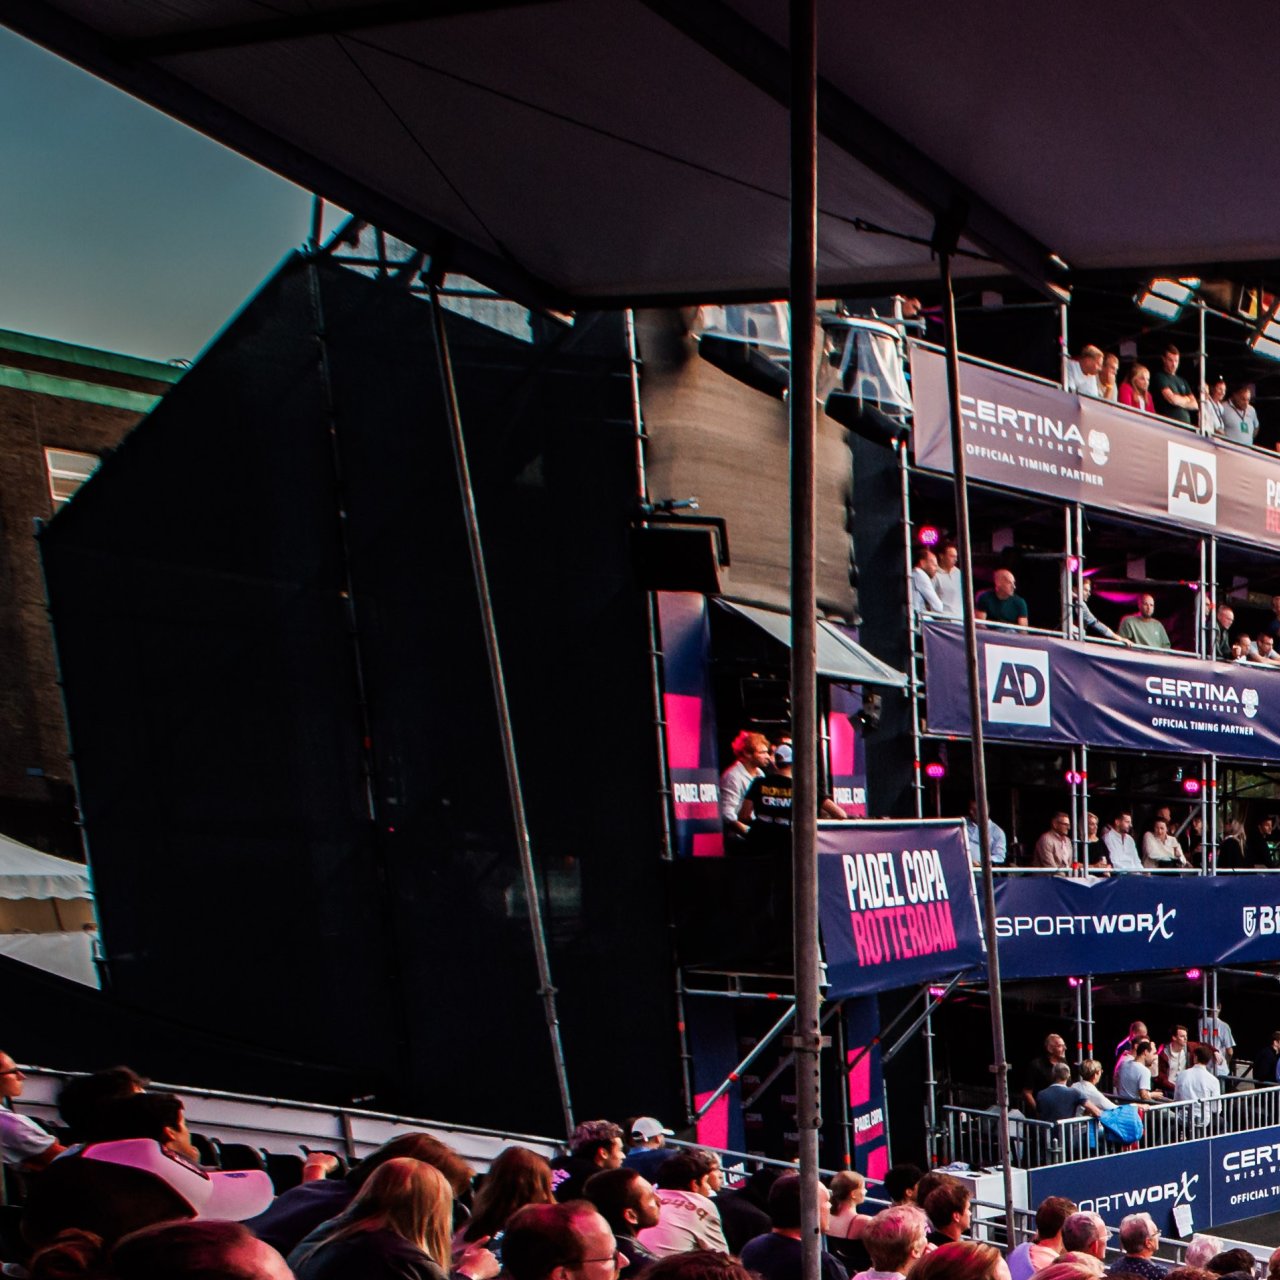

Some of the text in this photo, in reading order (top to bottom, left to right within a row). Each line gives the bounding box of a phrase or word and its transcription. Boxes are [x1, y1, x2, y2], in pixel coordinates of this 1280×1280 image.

[960, 395, 1085, 445] CERTINA
[966, 443, 1103, 486] OFFICIAL TIMING PARTNER
[1172, 460, 1213, 505] AD
[992, 662, 1045, 707] AD
[1146, 676, 1239, 703] CERTINA
[1152, 717, 1254, 736] OFFICIAL TIMING PARTNER
[843, 849, 949, 910] PADEL COPA
[851, 901, 957, 967] ROTTERDAM
[995, 902, 1176, 942] SPORTWORX
[1073, 1171, 1199, 1215] ORTWORX
[1225, 1168, 1264, 1183] SWISS
[1230, 1188, 1270, 1205] OFFICIAL
